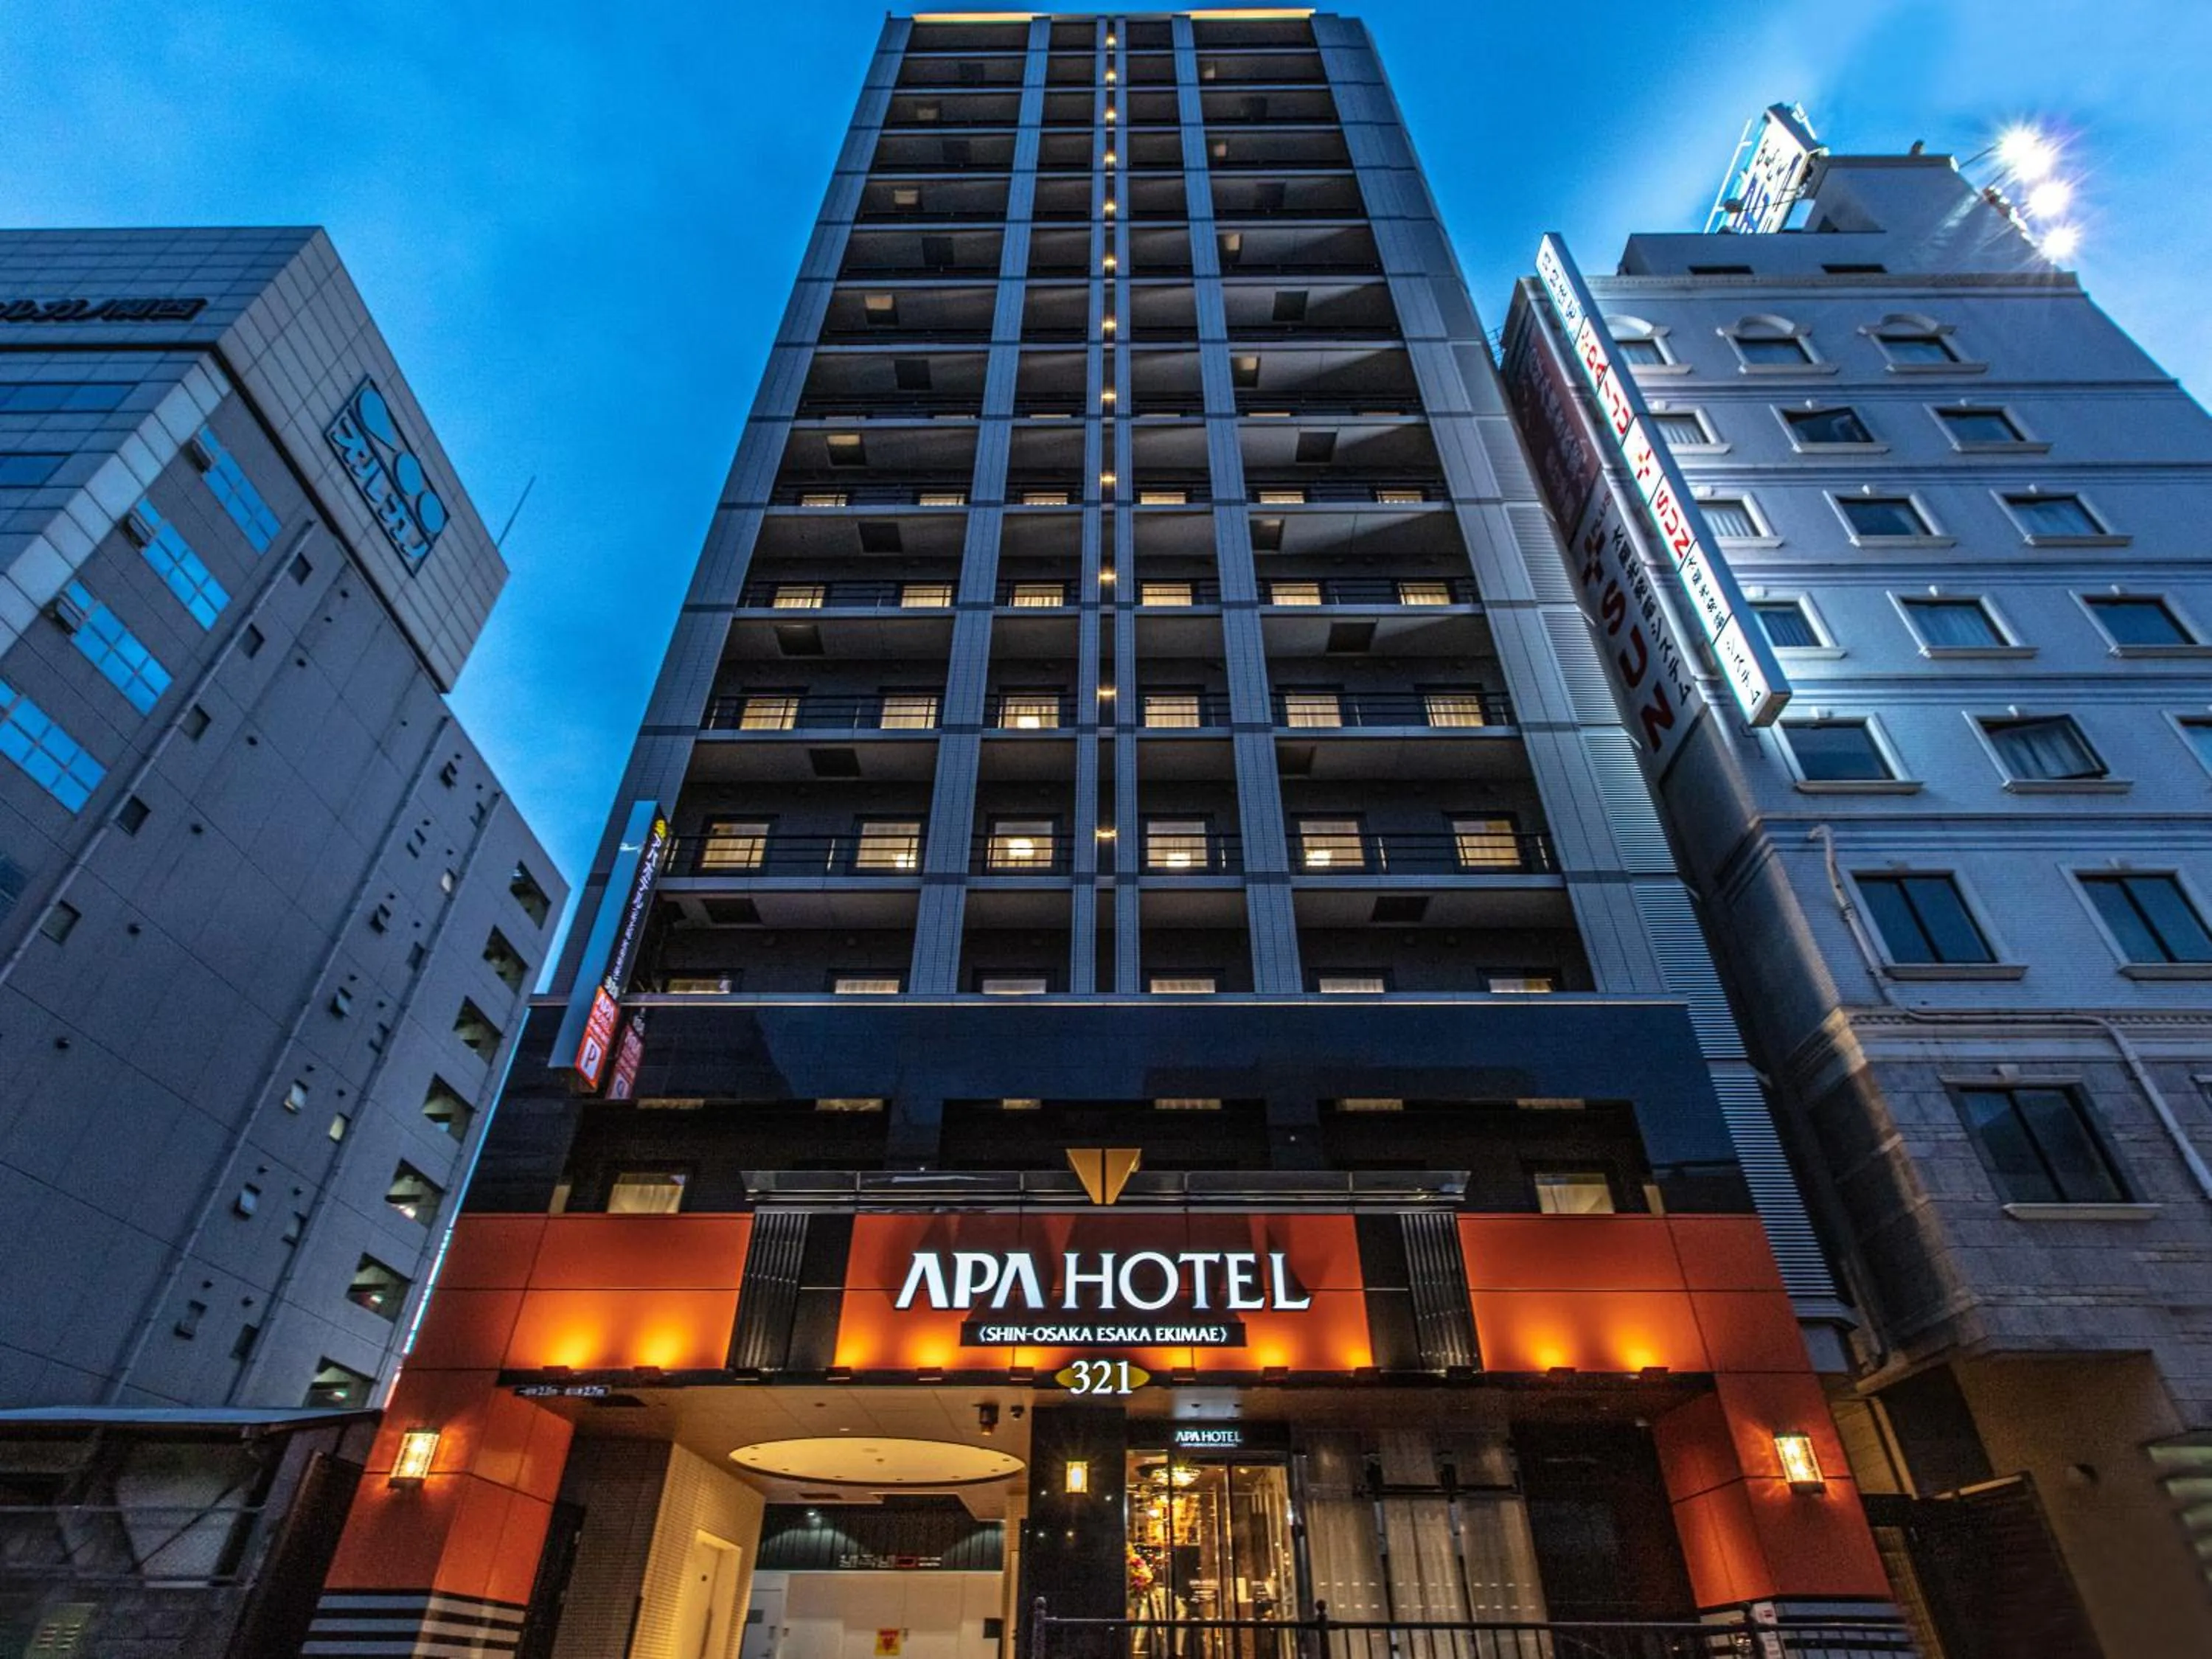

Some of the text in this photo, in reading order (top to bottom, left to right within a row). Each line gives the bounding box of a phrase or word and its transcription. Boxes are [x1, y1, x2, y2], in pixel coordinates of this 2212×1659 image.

[1657, 490, 1691, 559] SUN
[1601, 579, 1675, 754] SUN
[894, 1251, 1310, 1310] APA HOTEL
[1096, 1327, 1151, 1342] ESAKA
[1071, 1360, 1133, 1394] 321
[1175, 1431, 1242, 1442] APA HOTEL
